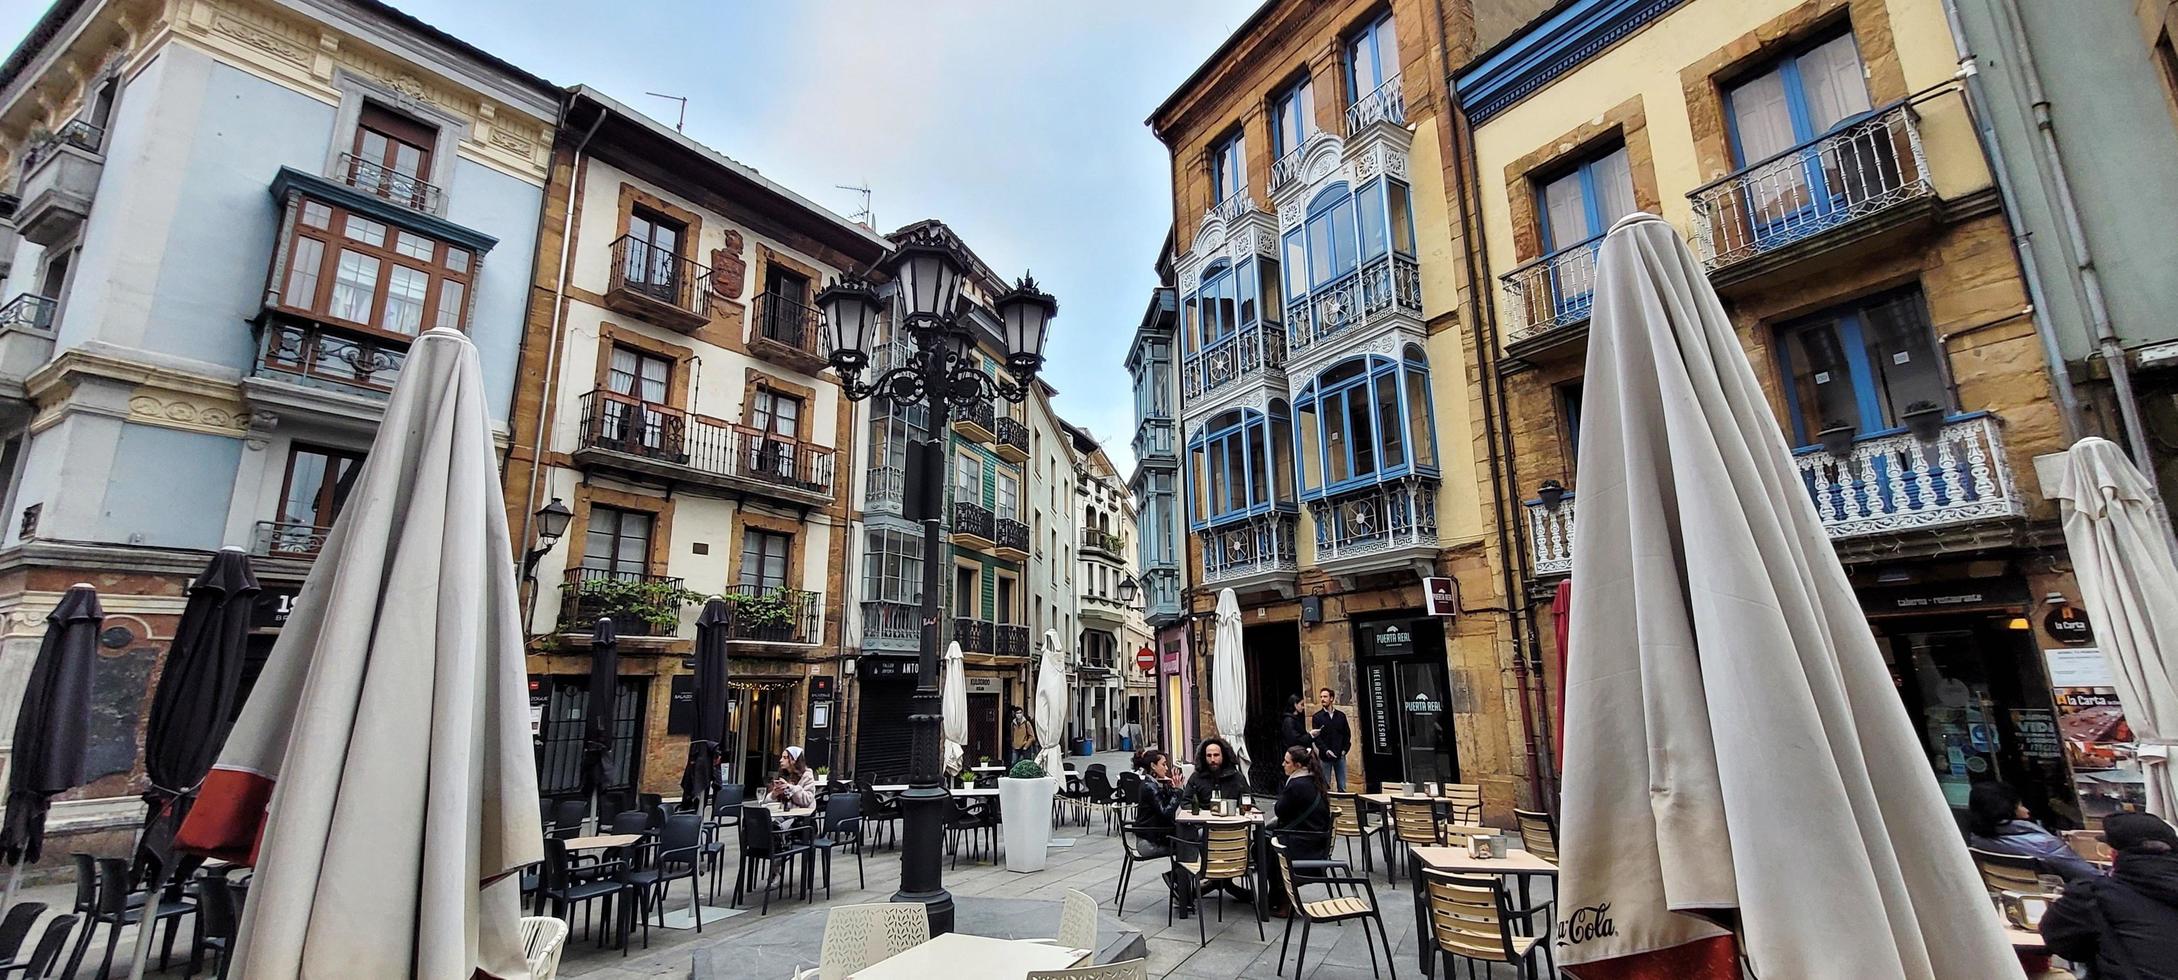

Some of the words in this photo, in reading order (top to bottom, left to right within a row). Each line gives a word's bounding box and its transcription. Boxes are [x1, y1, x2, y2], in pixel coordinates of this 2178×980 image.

[2063, 621, 2086, 630] Carta
[1376, 633, 1397, 643] PUERTA
[1398, 632, 1411, 642] REAL
[902, 663, 919, 674] ANTO
[2067, 695, 2076, 706] la
[2077, 695, 2106, 706] Carta
[1404, 701, 1427, 712] PUERTA
[1427, 701, 1442, 712] REAL
[1376, 710, 1388, 747] ARTESANA
